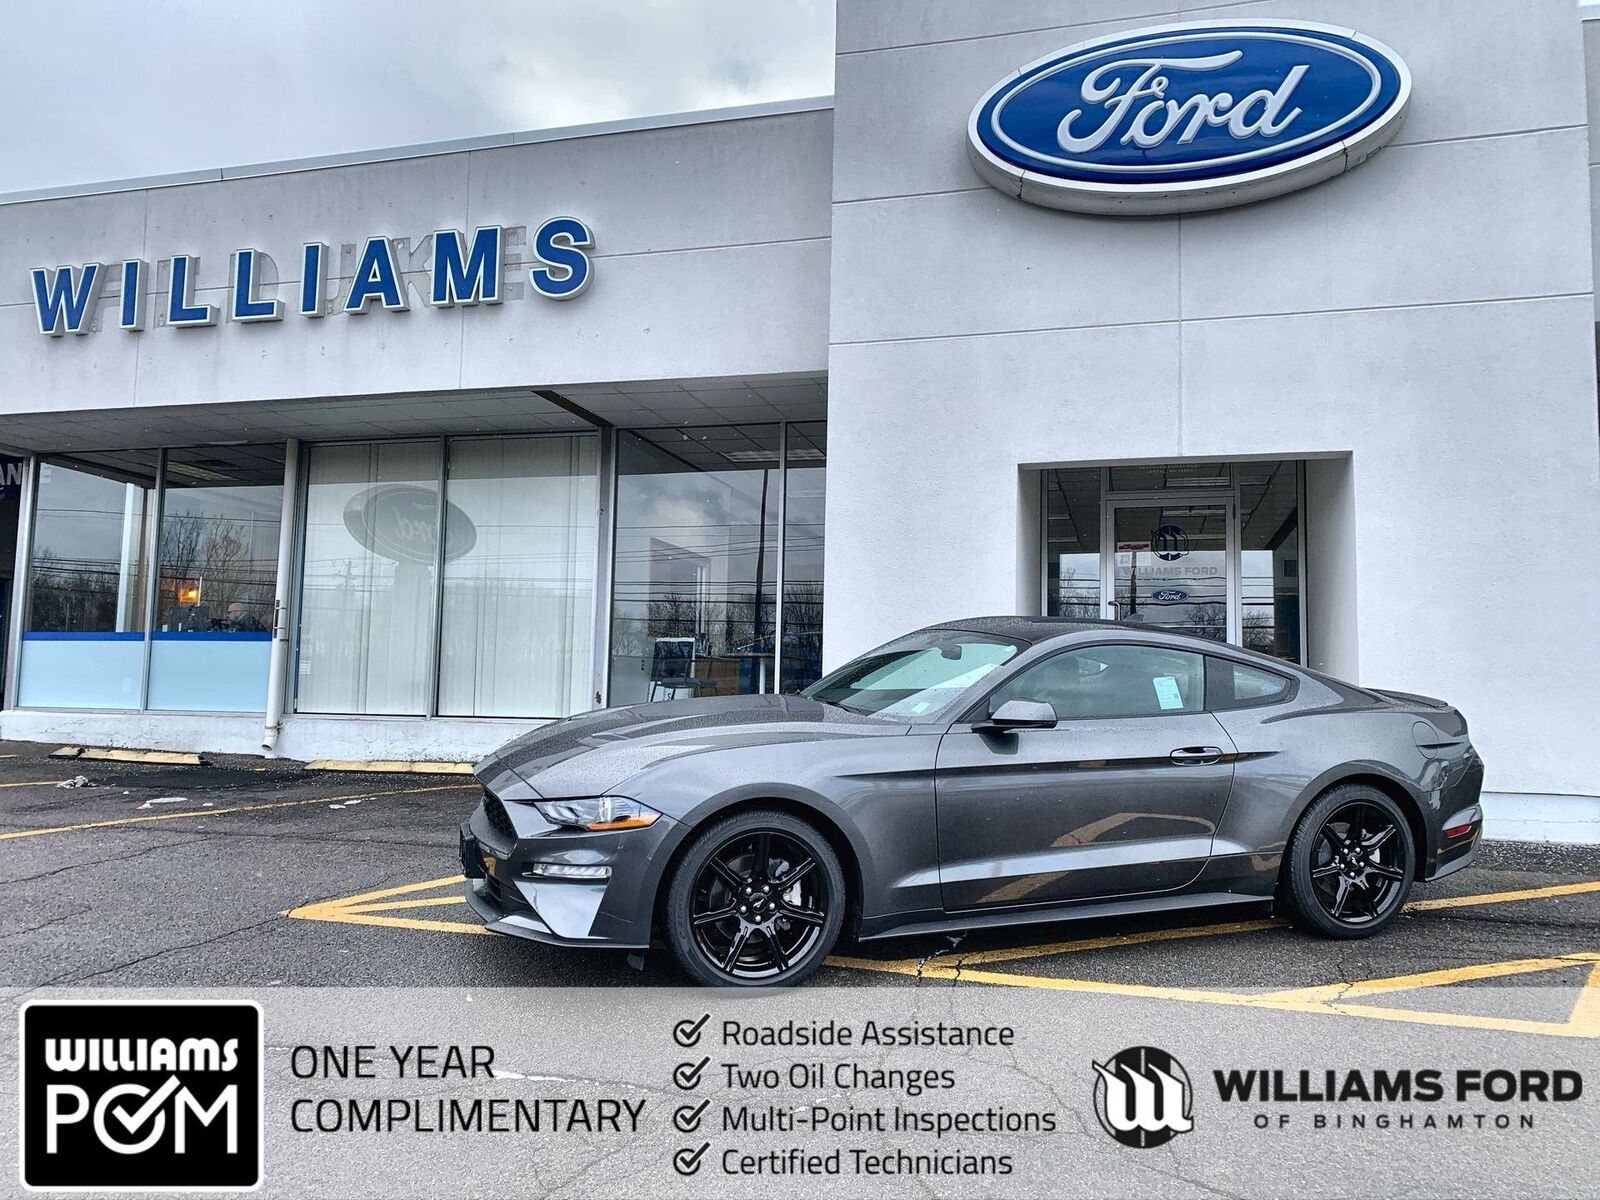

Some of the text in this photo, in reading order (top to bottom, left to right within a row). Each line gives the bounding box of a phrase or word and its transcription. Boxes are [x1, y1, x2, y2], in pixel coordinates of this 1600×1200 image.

[1056, 49, 1311, 154] Ford
[30, 215, 596, 337] WILLIAMS
[1123, 566, 1218, 577] WLLIAMS FORD
[1158, 590, 1185, 601] Ford
